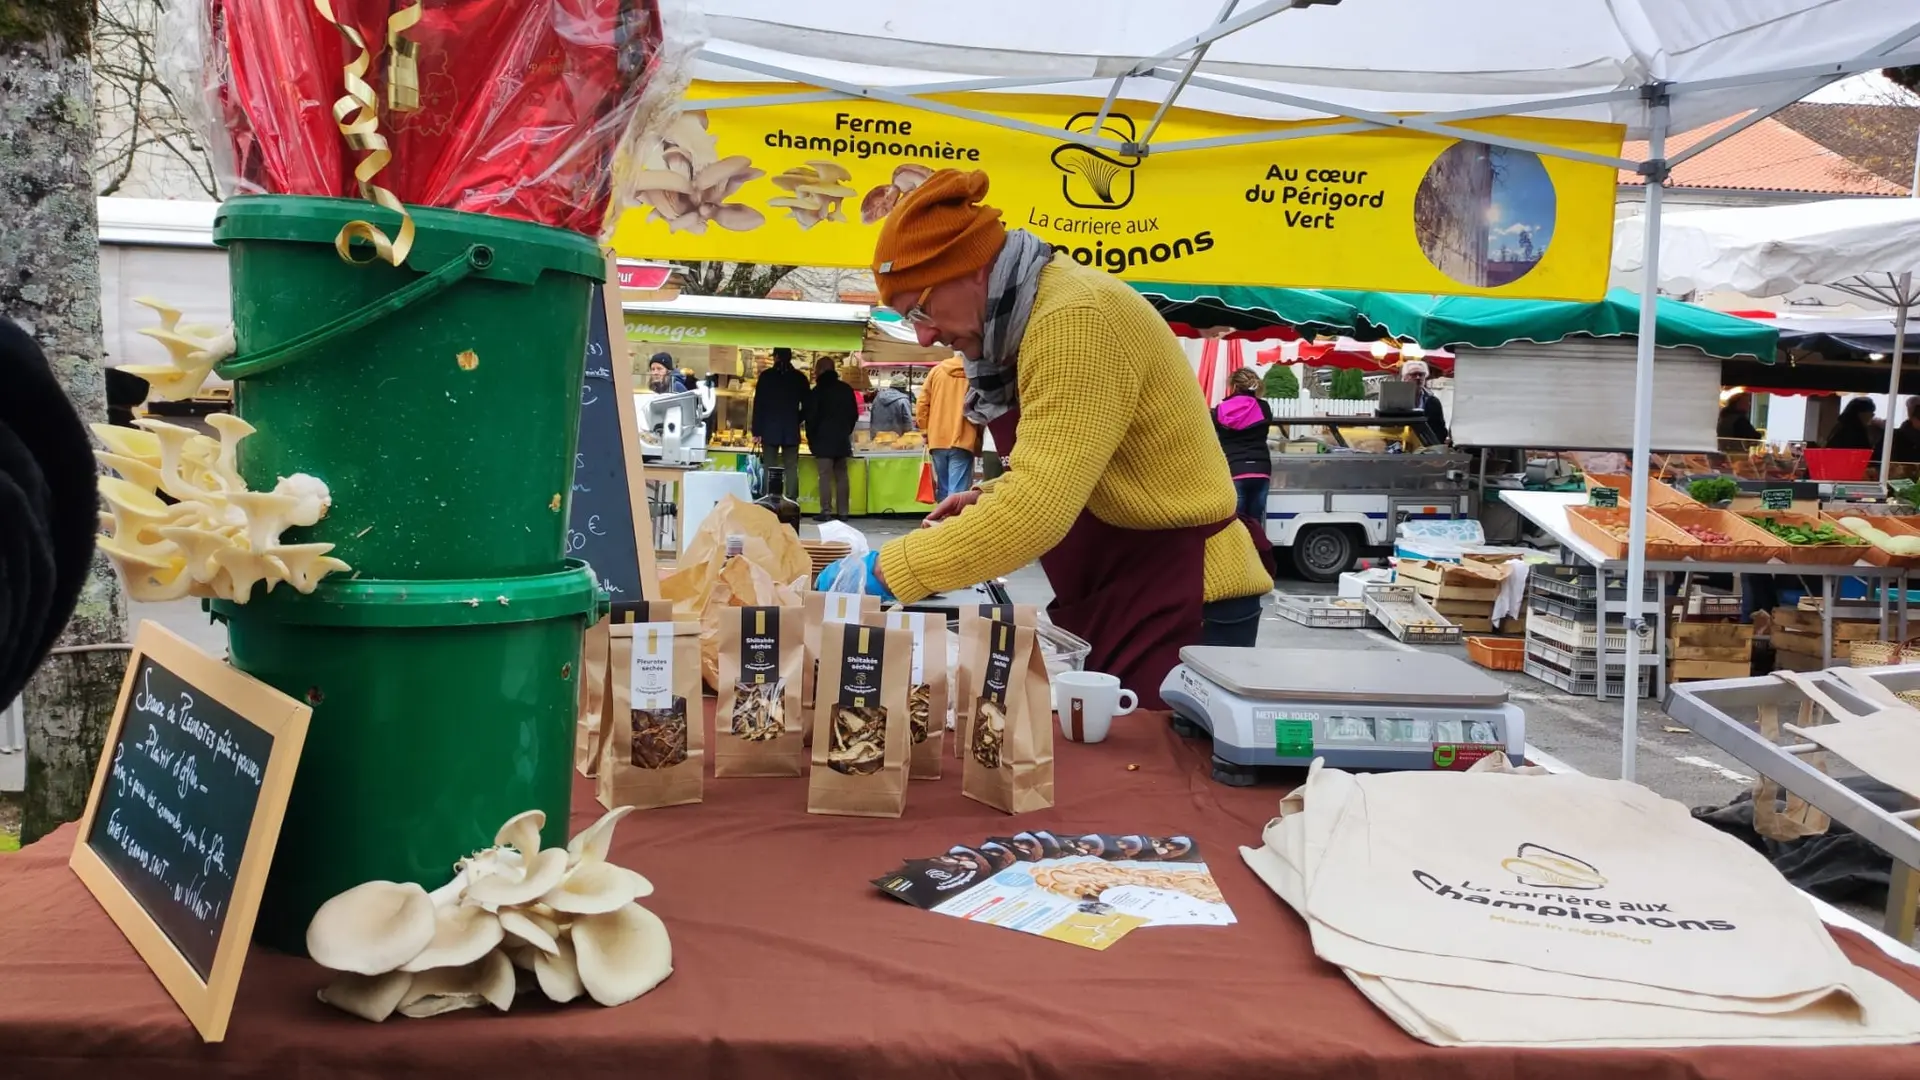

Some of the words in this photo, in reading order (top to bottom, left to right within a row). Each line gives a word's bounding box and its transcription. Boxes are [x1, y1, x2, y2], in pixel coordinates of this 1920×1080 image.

[835, 113, 912, 135] Ferme
[764, 129, 980, 161] champignonnière
[1265, 164, 1298, 181] Au
[1305, 169, 1368, 184] cœur
[1245, 184, 1275, 203] du
[1282, 186, 1384, 211] Périgord
[1028, 206, 1049, 228] La
[1053, 217, 1122, 235] carriere
[1126, 217, 1160, 234] aux
[1284, 210, 1335, 229] Vert
[847, 656, 878, 665] Shiitakés
[851, 663, 875, 671] séchés
[1256, 710, 1287, 719] METTLER
[1291, 711, 1320, 721] TOLEDO
[1412, 869, 1737, 932] Champignons
[1460, 880, 1491, 893] La
[1499, 889, 1612, 909] carrière
[1618, 901, 1675, 913] aux
